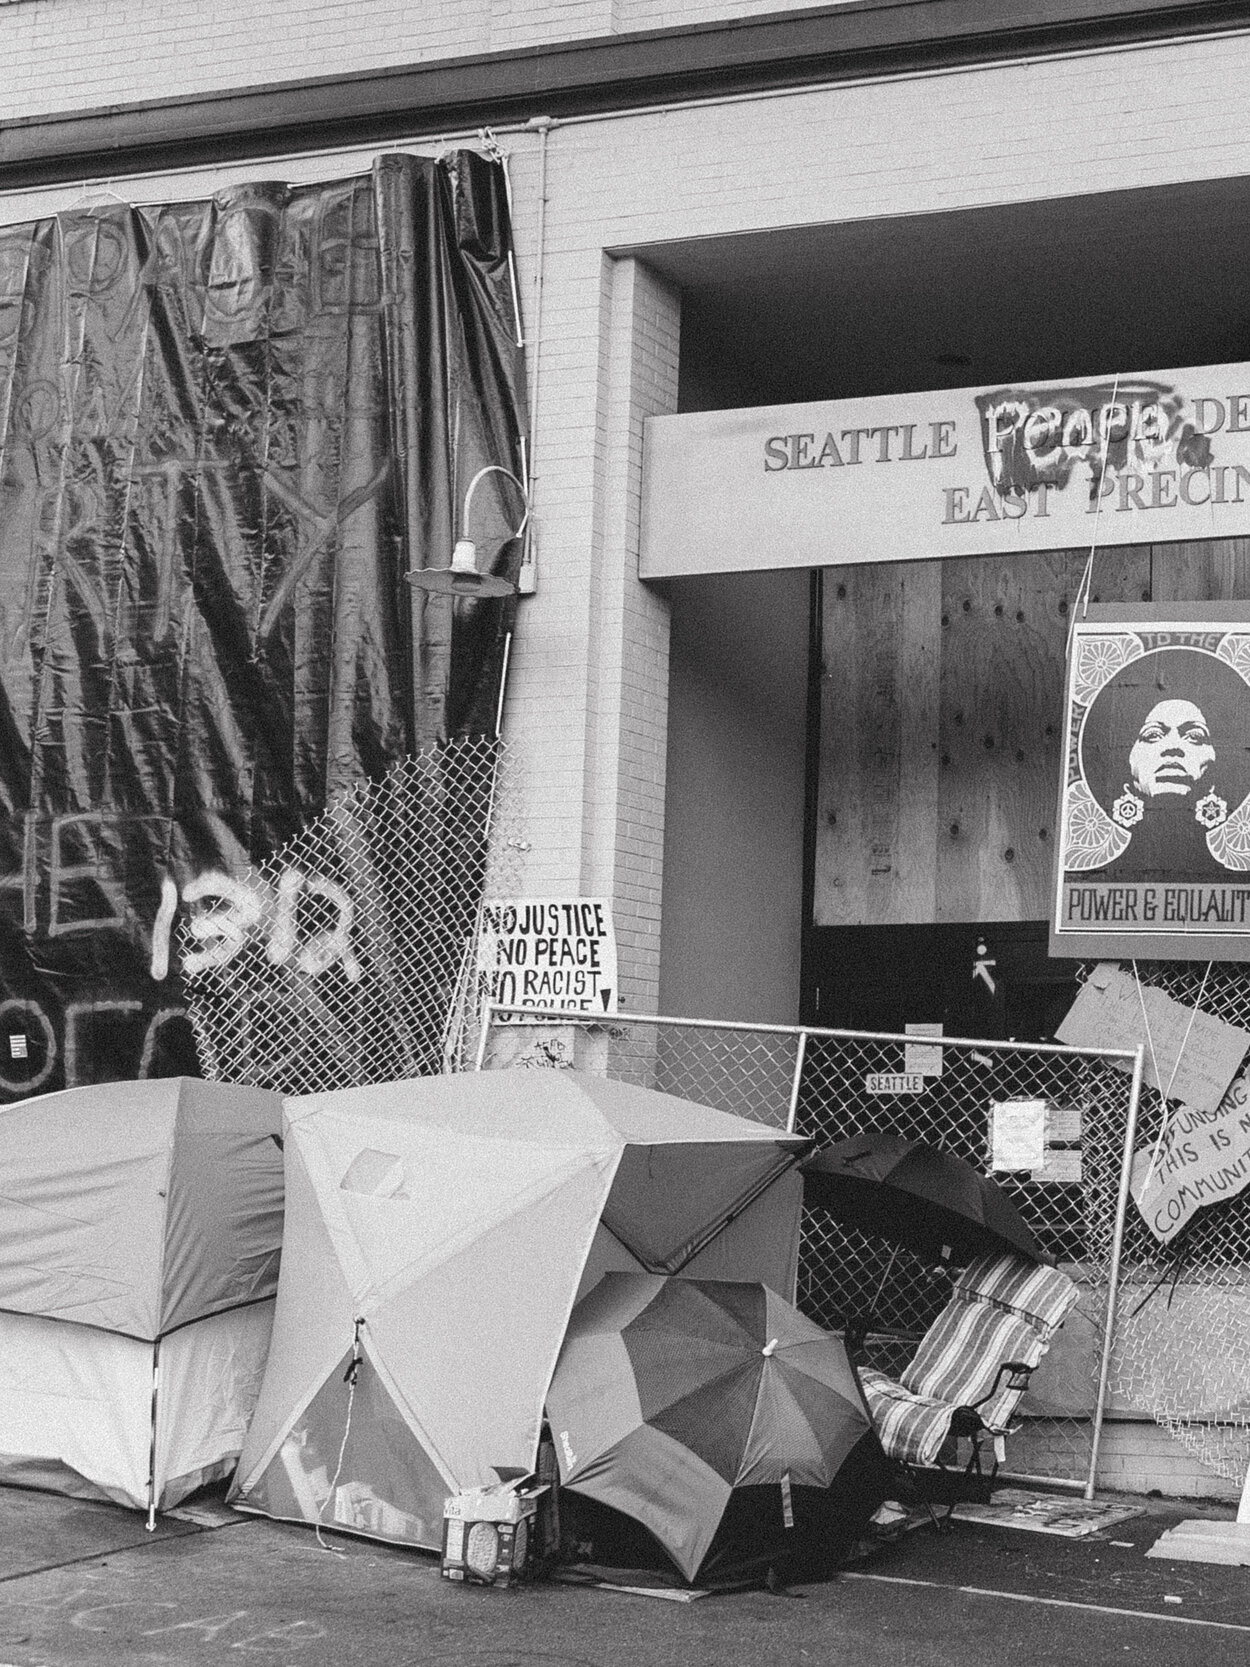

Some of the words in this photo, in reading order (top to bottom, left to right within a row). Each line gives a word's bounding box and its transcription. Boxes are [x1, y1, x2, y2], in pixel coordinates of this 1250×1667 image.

[764, 420, 957, 472] SEATTLE
[942, 482, 1060, 524] EAST
[1140, 632, 1172, 646] TO
[1174, 633, 1223, 650] THE
[1068, 704, 1085, 783] POWER
[482, 905, 518, 935] NO
[518, 904, 607, 937] JUSTICE
[1068, 888, 1138, 921] POWER
[1143, 888, 1159, 921] &
[497, 938, 528, 966] NO
[534, 938, 601, 968] PEACE
[523, 969, 602, 997] RACIST
[870, 1076, 920, 1092] SEATTLE
[1154, 1142, 1199, 1185] THIS
[1209, 1128, 1231, 1150] IS
